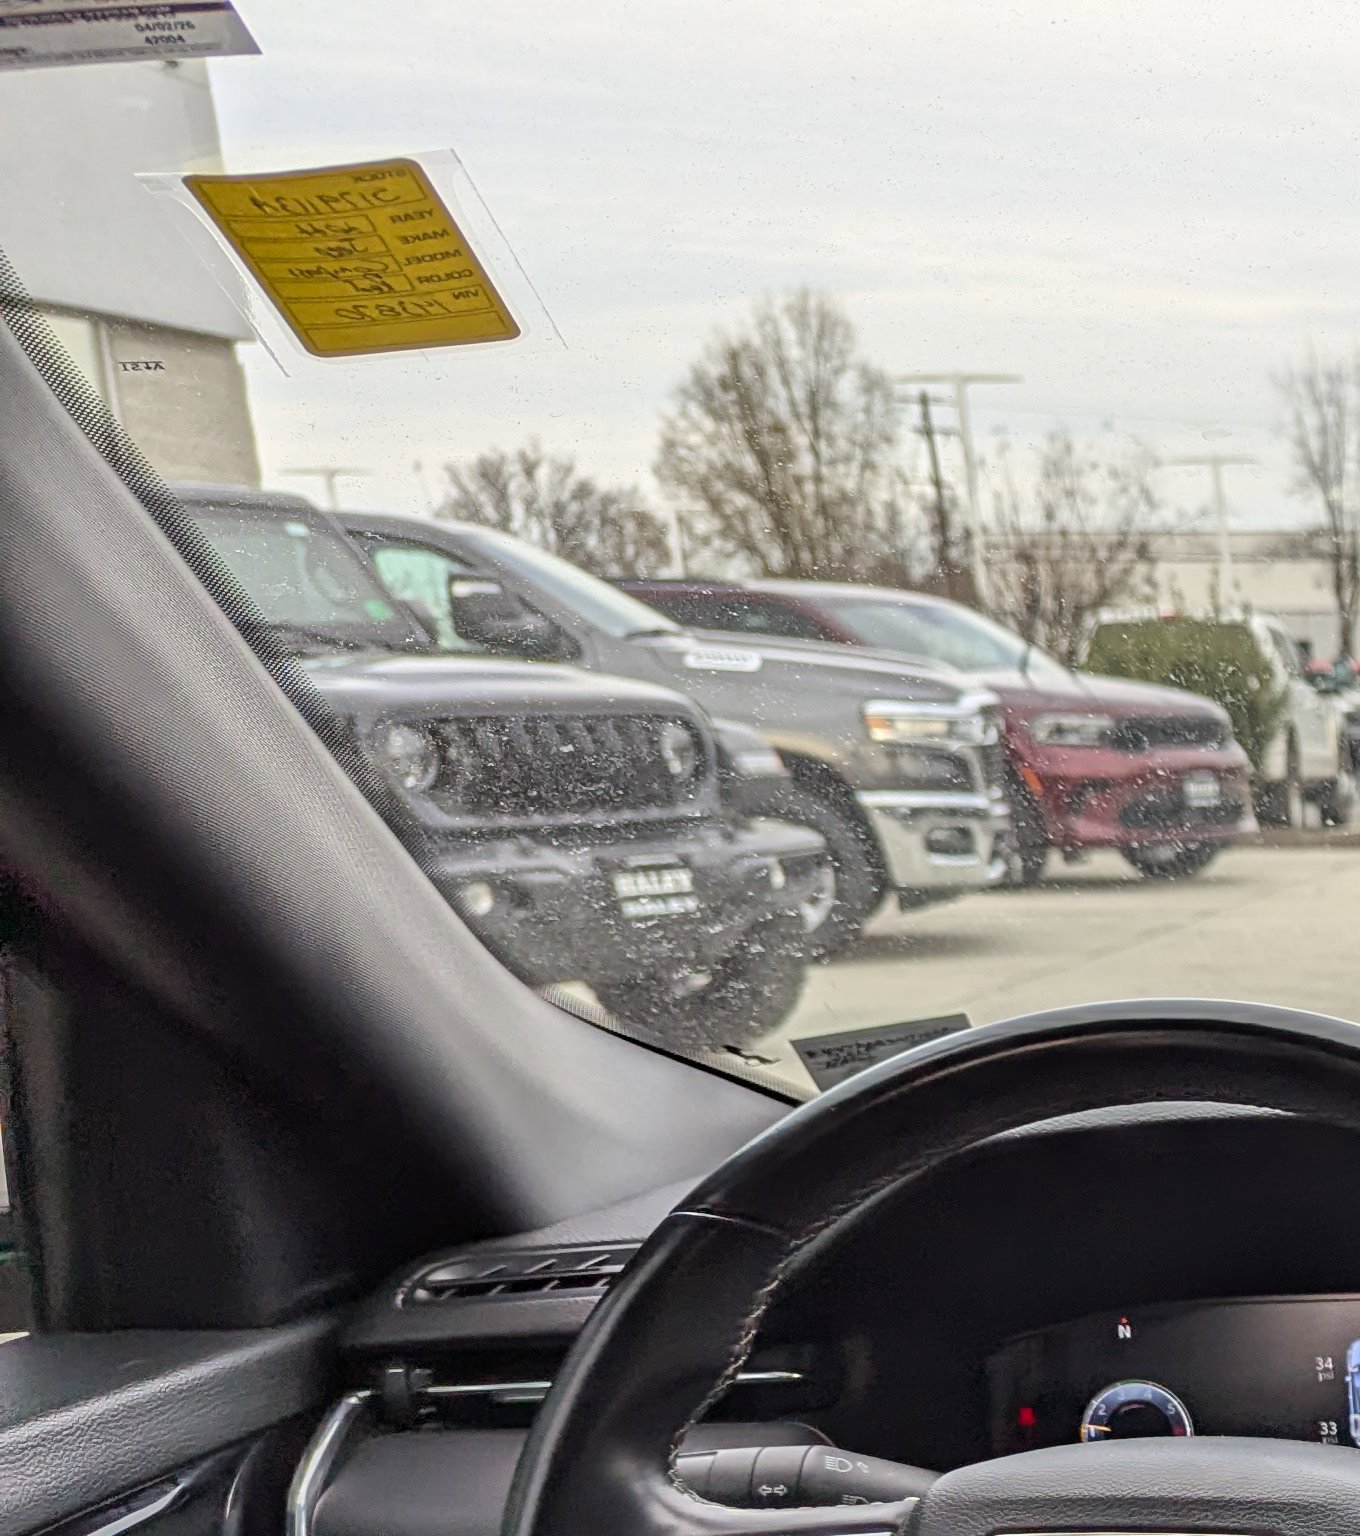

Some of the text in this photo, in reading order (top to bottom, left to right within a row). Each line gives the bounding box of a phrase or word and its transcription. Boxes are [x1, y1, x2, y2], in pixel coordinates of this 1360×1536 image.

[1117, 1325, 1132, 1339] N
[1315, 1356, 1333, 1371] 34
[1319, 1421, 1338, 1436] 33
